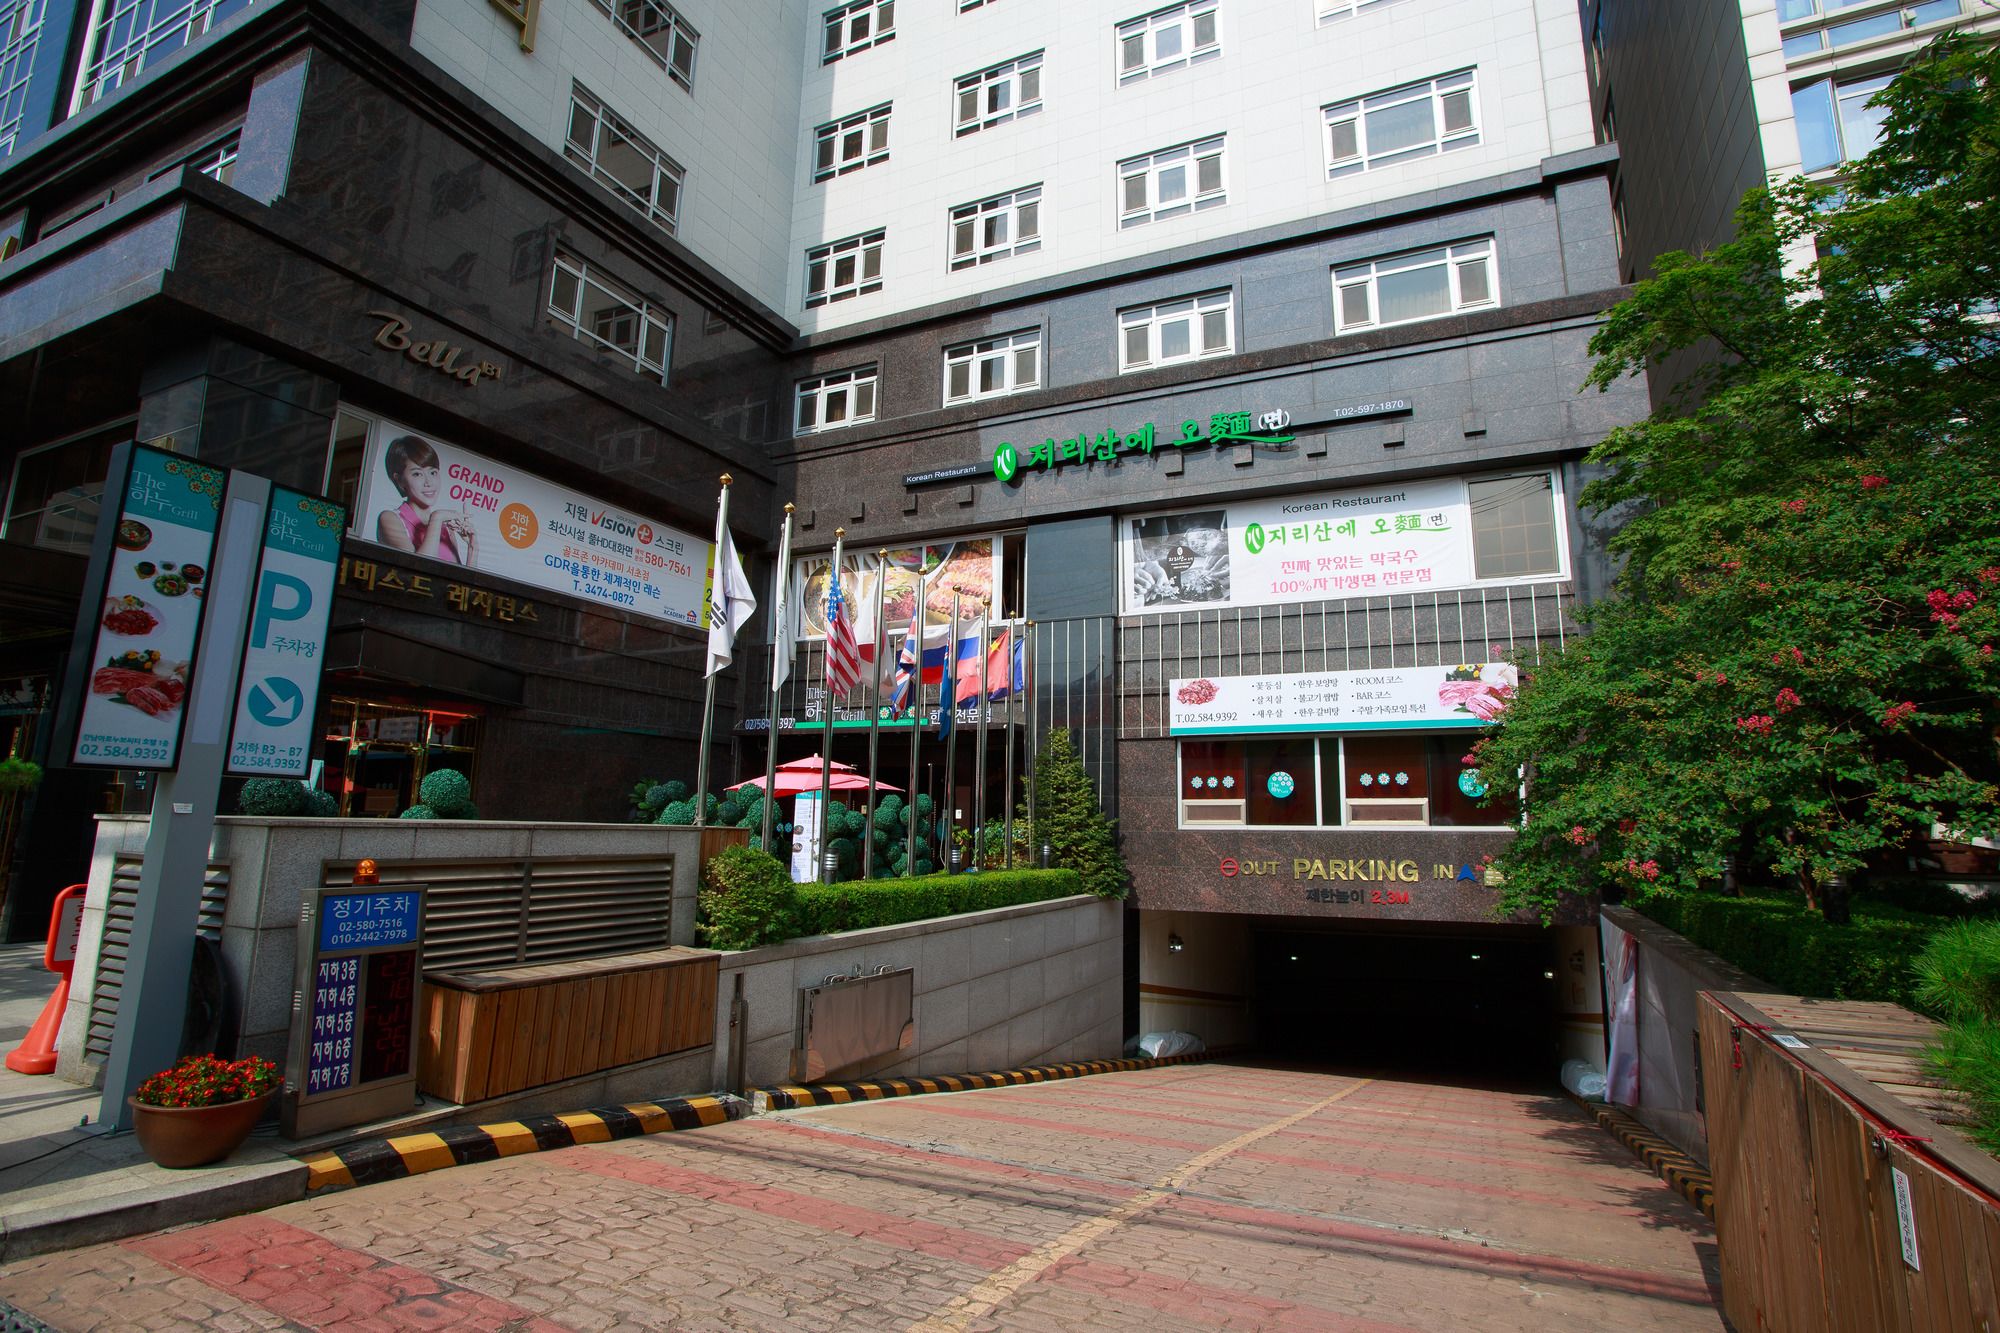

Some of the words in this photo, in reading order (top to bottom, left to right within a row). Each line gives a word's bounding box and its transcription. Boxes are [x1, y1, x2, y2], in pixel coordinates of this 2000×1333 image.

[367, 310, 481, 386] Bella
[1333, 399, 1404, 418] T.02-597-1870
[1027, 422, 1155, 469] 지리산에
[132, 470, 167, 491] The
[448, 463, 505, 493] GRAND
[906, 472, 933, 483] Korean
[934, 465, 977, 479] Restaurant
[130, 487, 173, 512] 하누
[171, 506, 199, 520] Grill
[449, 485, 499, 512] OPEN!
[1282, 502, 1328, 514] Korean
[1332, 491, 1406, 508] Restaurant
[271, 508, 298, 526] The
[511, 510, 529, 526] 지하
[564, 502, 588, 523] 지원
[591, 510, 637, 538] VISION
[654, 535, 684, 556] 스크린
[270, 522, 304, 544] 하누
[302, 541, 325, 553] Grill
[509, 524, 528, 540] 2F
[547, 519, 586, 543] 최신시설
[588, 533, 633, 558] 풀HD대화면
[1268, 519, 1356, 545] 지리산에
[591, 554, 625, 574] 아카데미
[626, 566, 650, 582] 서초점
[644, 552, 693, 578] 580-7561
[1281, 559, 1311, 575] 진짜
[1317, 555, 1363, 571] 맛있는
[1370, 549, 1419, 566] 막국수
[603, 571, 641, 594] 체계적인
[643, 584, 661, 600] 레슨
[1382, 567, 1432, 586] 전문점
[447, 583, 539, 622] 레지던스
[585, 583, 635, 606] 3474-0872
[251, 569, 313, 649] P
[272, 636, 317, 657] 주차장
[1355, 677, 1385, 685] ROOM
[1385, 676, 1403, 684] 코스
[1356, 692, 1373, 700] BAR
[1375, 691, 1392, 699] 코스
[1176, 712, 1238, 723] T.02.584.9392
[80, 743, 168, 760] 02.584.9392
[235, 741, 259, 755] 지하
[262, 744, 276, 755] B3
[288, 746, 303, 757] B7
[232, 754, 302, 769] 02.584.9392
[1240, 860, 1279, 876] OUT
[1293, 858, 1420, 882] PARKING
[1433, 864, 1454, 879] IN
[332, 895, 411, 919] 정기주차
[1370, 889, 1410, 905] 2.3M
[331, 929, 408, 945] 010-2442-7978
[338, 918, 403, 932] 02-580-7516
[319, 959, 358, 983] 지하3층
[317, 984, 356, 1009] 지하4층
[315, 1011, 353, 1036] 지하5층
[312, 1037, 352, 1062] 지하6층
[310, 1063, 350, 1089] 지하7층
